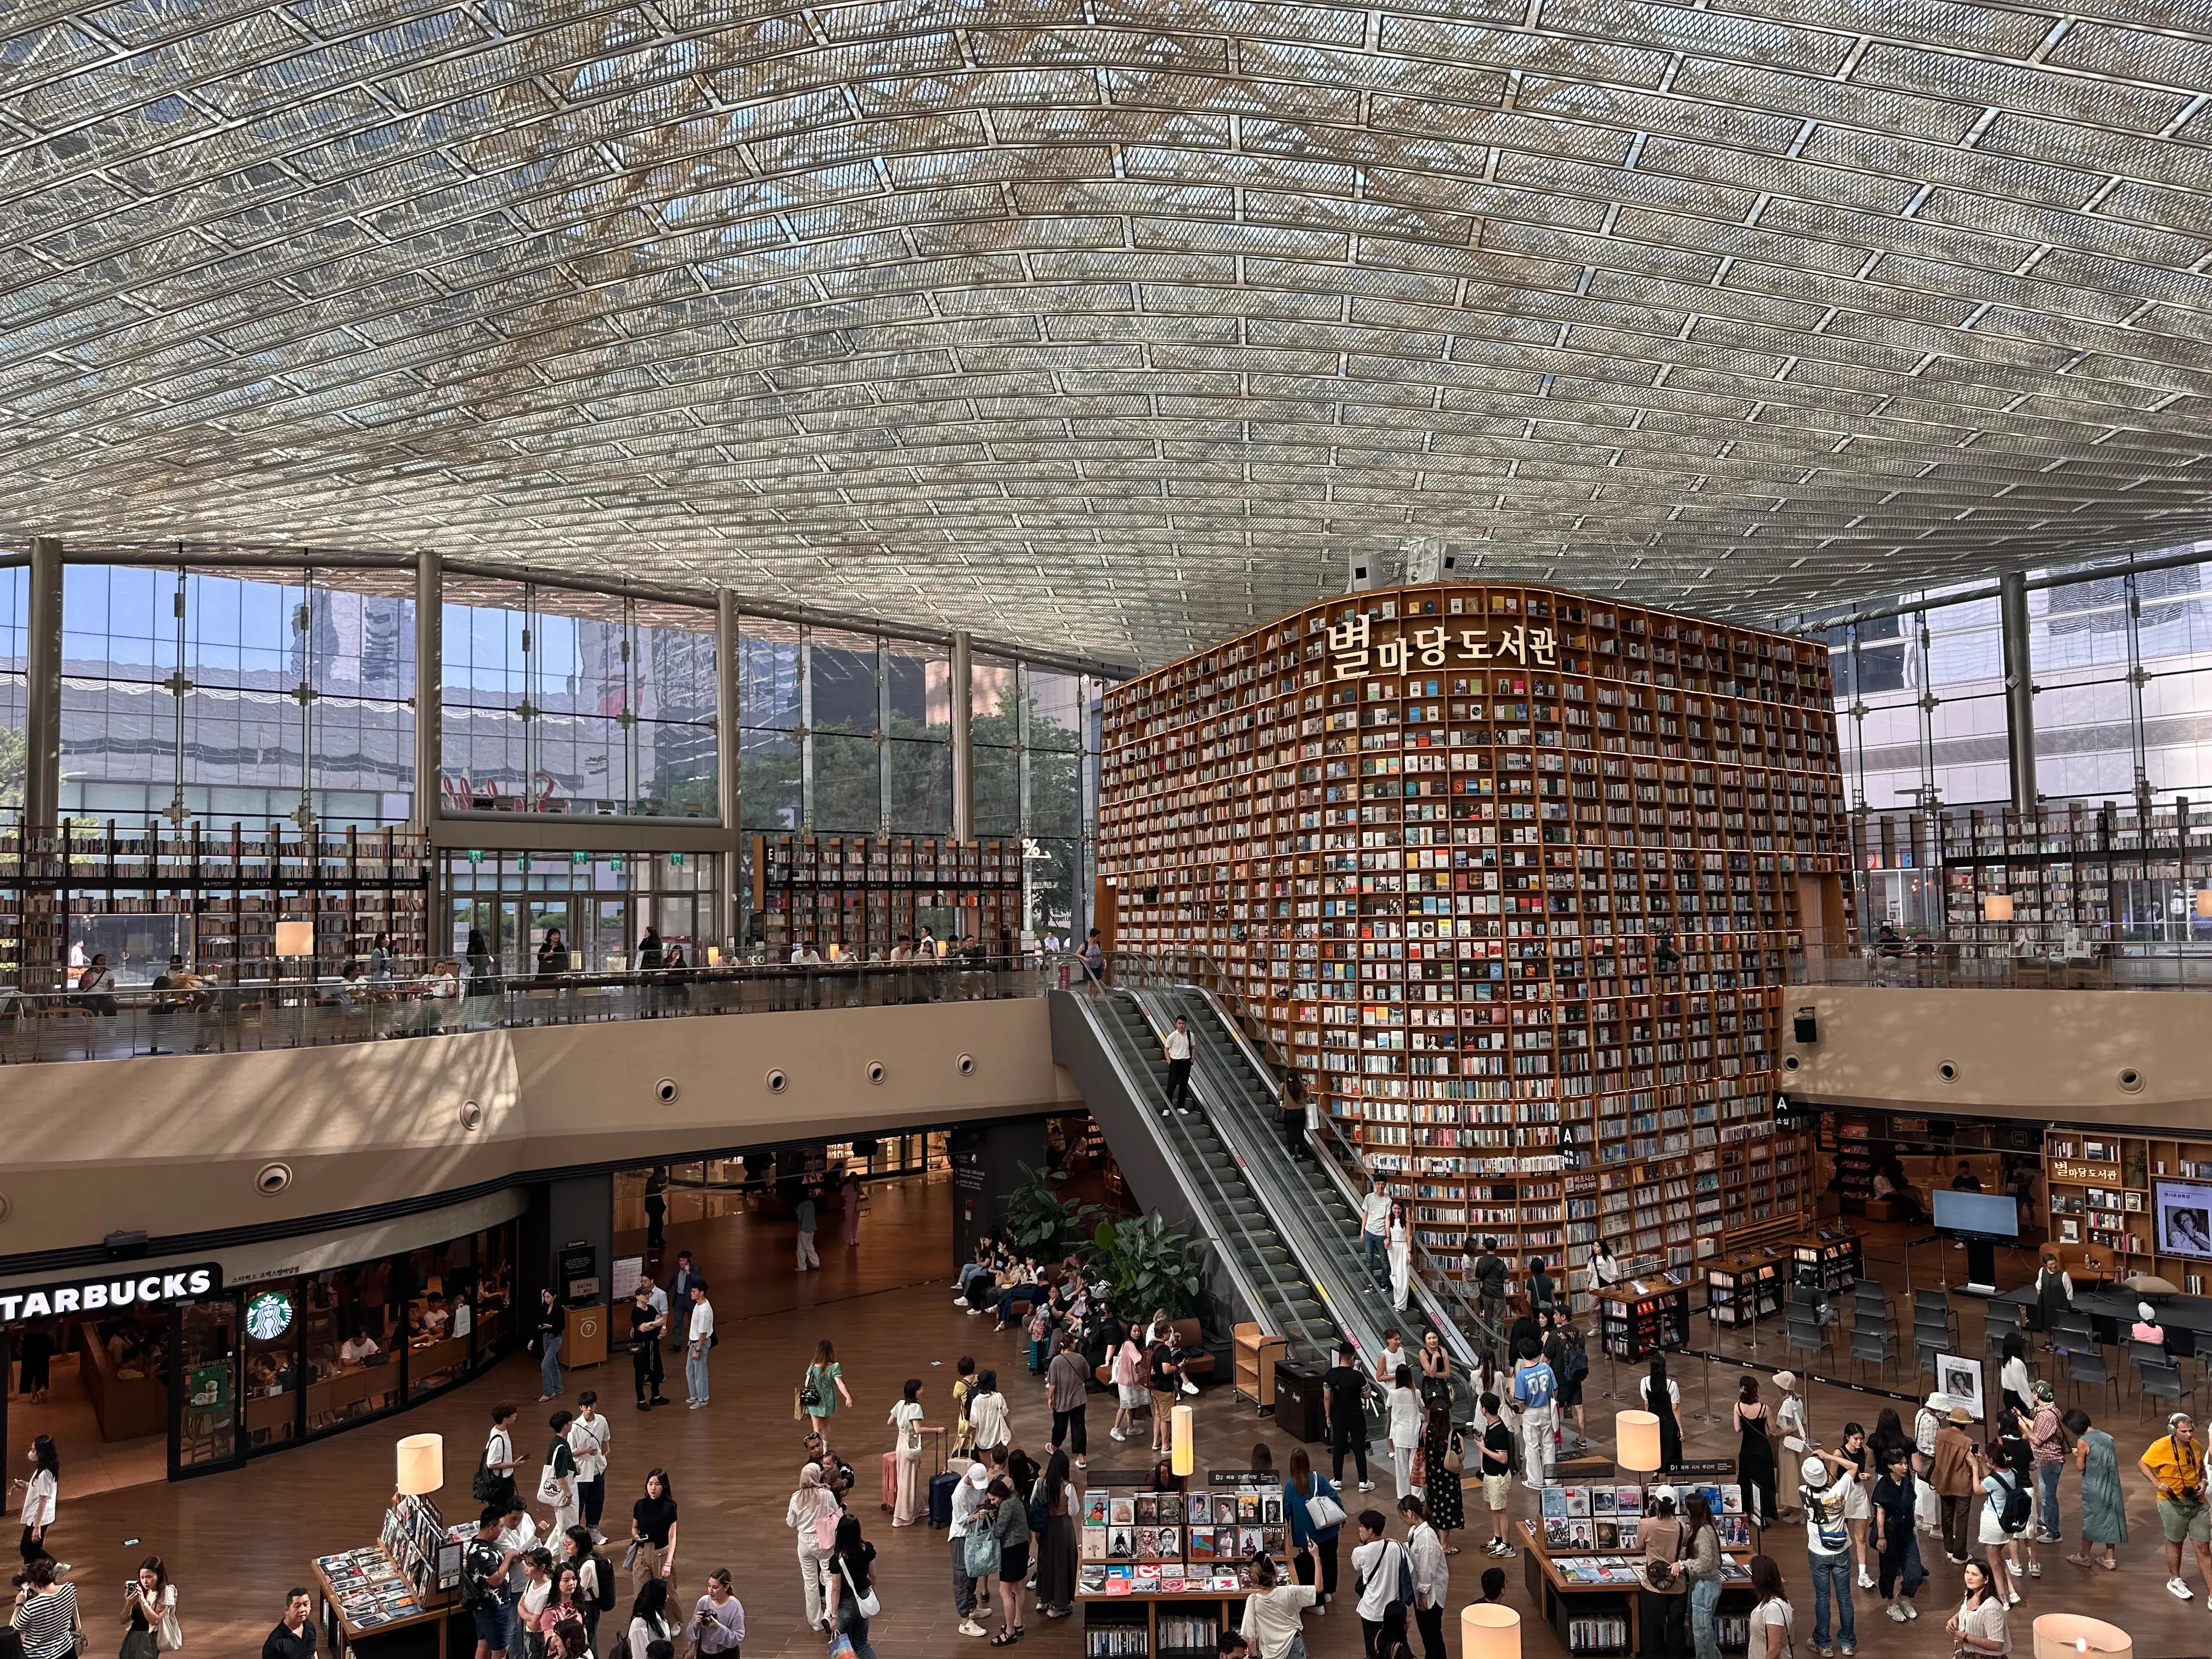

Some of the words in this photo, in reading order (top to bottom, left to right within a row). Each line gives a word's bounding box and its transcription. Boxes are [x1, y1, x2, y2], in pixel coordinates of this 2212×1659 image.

[1326, 613, 1451, 679] 별마당
[1457, 625, 1557, 665] 도서관
[426, 842, 430, 854] E
[768, 848, 773, 860] E
[1777, 1097, 1787, 1109] A
[1564, 1128, 1573, 1143] A
[1564, 1149, 1573, 1158] 무역
[2054, 1160, 2087, 1178] 별마당
[2088, 1169, 2117, 1180] 도서관
[1574, 1173, 1596, 1184] 비즈니스
[1575, 1181, 1596, 1191] 라이브러리
[232, 1274, 257, 1283] 스타벅스
[1527, 1374, 1549, 1395] 08
